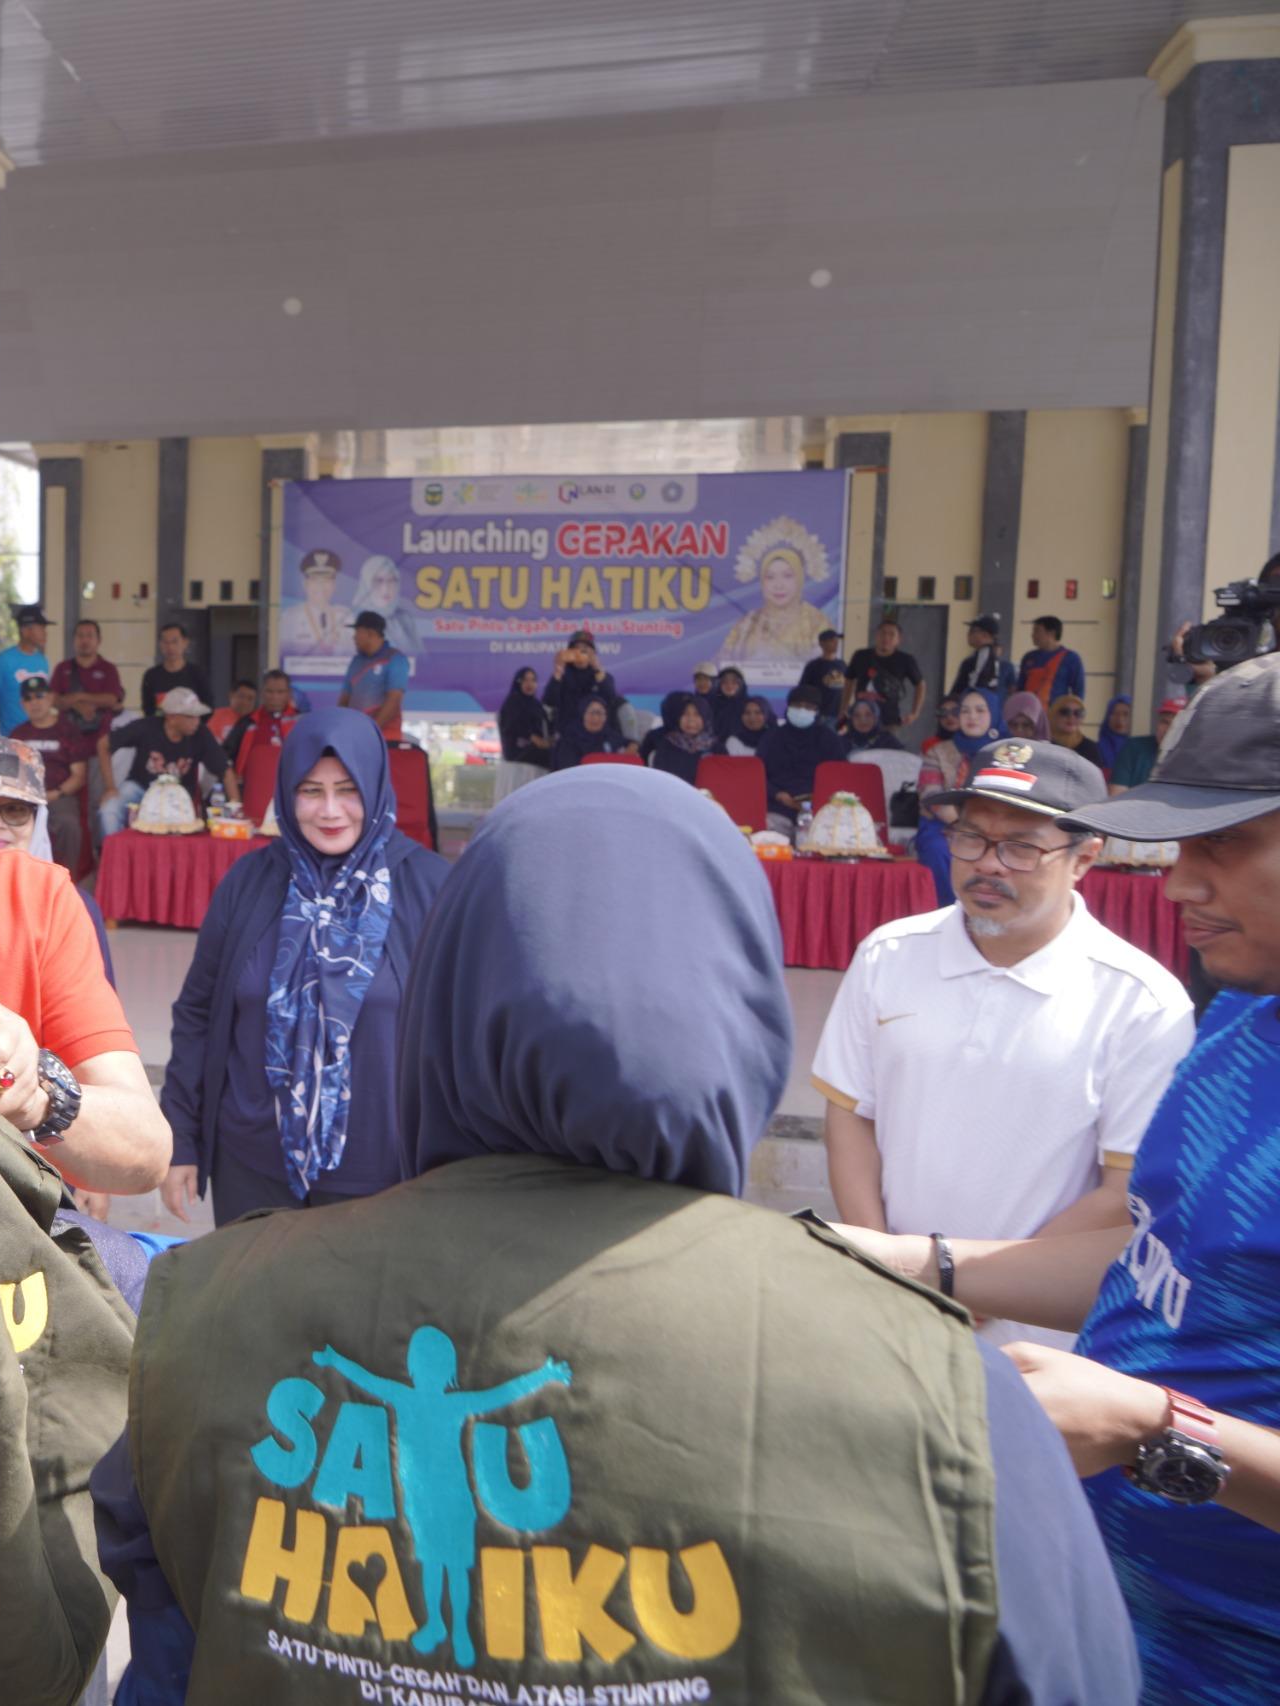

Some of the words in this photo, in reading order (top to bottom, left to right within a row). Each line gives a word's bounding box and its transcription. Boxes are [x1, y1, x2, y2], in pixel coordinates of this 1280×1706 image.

[403, 519, 549, 560] Launching
[556, 520, 729, 558] GERAKAN
[415, 565, 530, 611] SATU
[538, 565, 713, 612] HATIKU
[434, 618, 464, 632] Satu
[468, 618, 504, 632] Pintu
[508, 618, 549, 635] Cegah
[621, 619, 683, 637] Stunting
[489, 641, 503, 653] DI
[267, 1629, 318, 1665] SATU
[323, 1648, 382, 1680] PINTU
[390, 1663, 461, 1694] CEGAH
[466, 1674, 509, 1704] DAN
[517, 1683, 585, 1706] ATASI
[593, 1676, 711, 1705] STUNTING
[360, 1679, 383, 1703] DI
